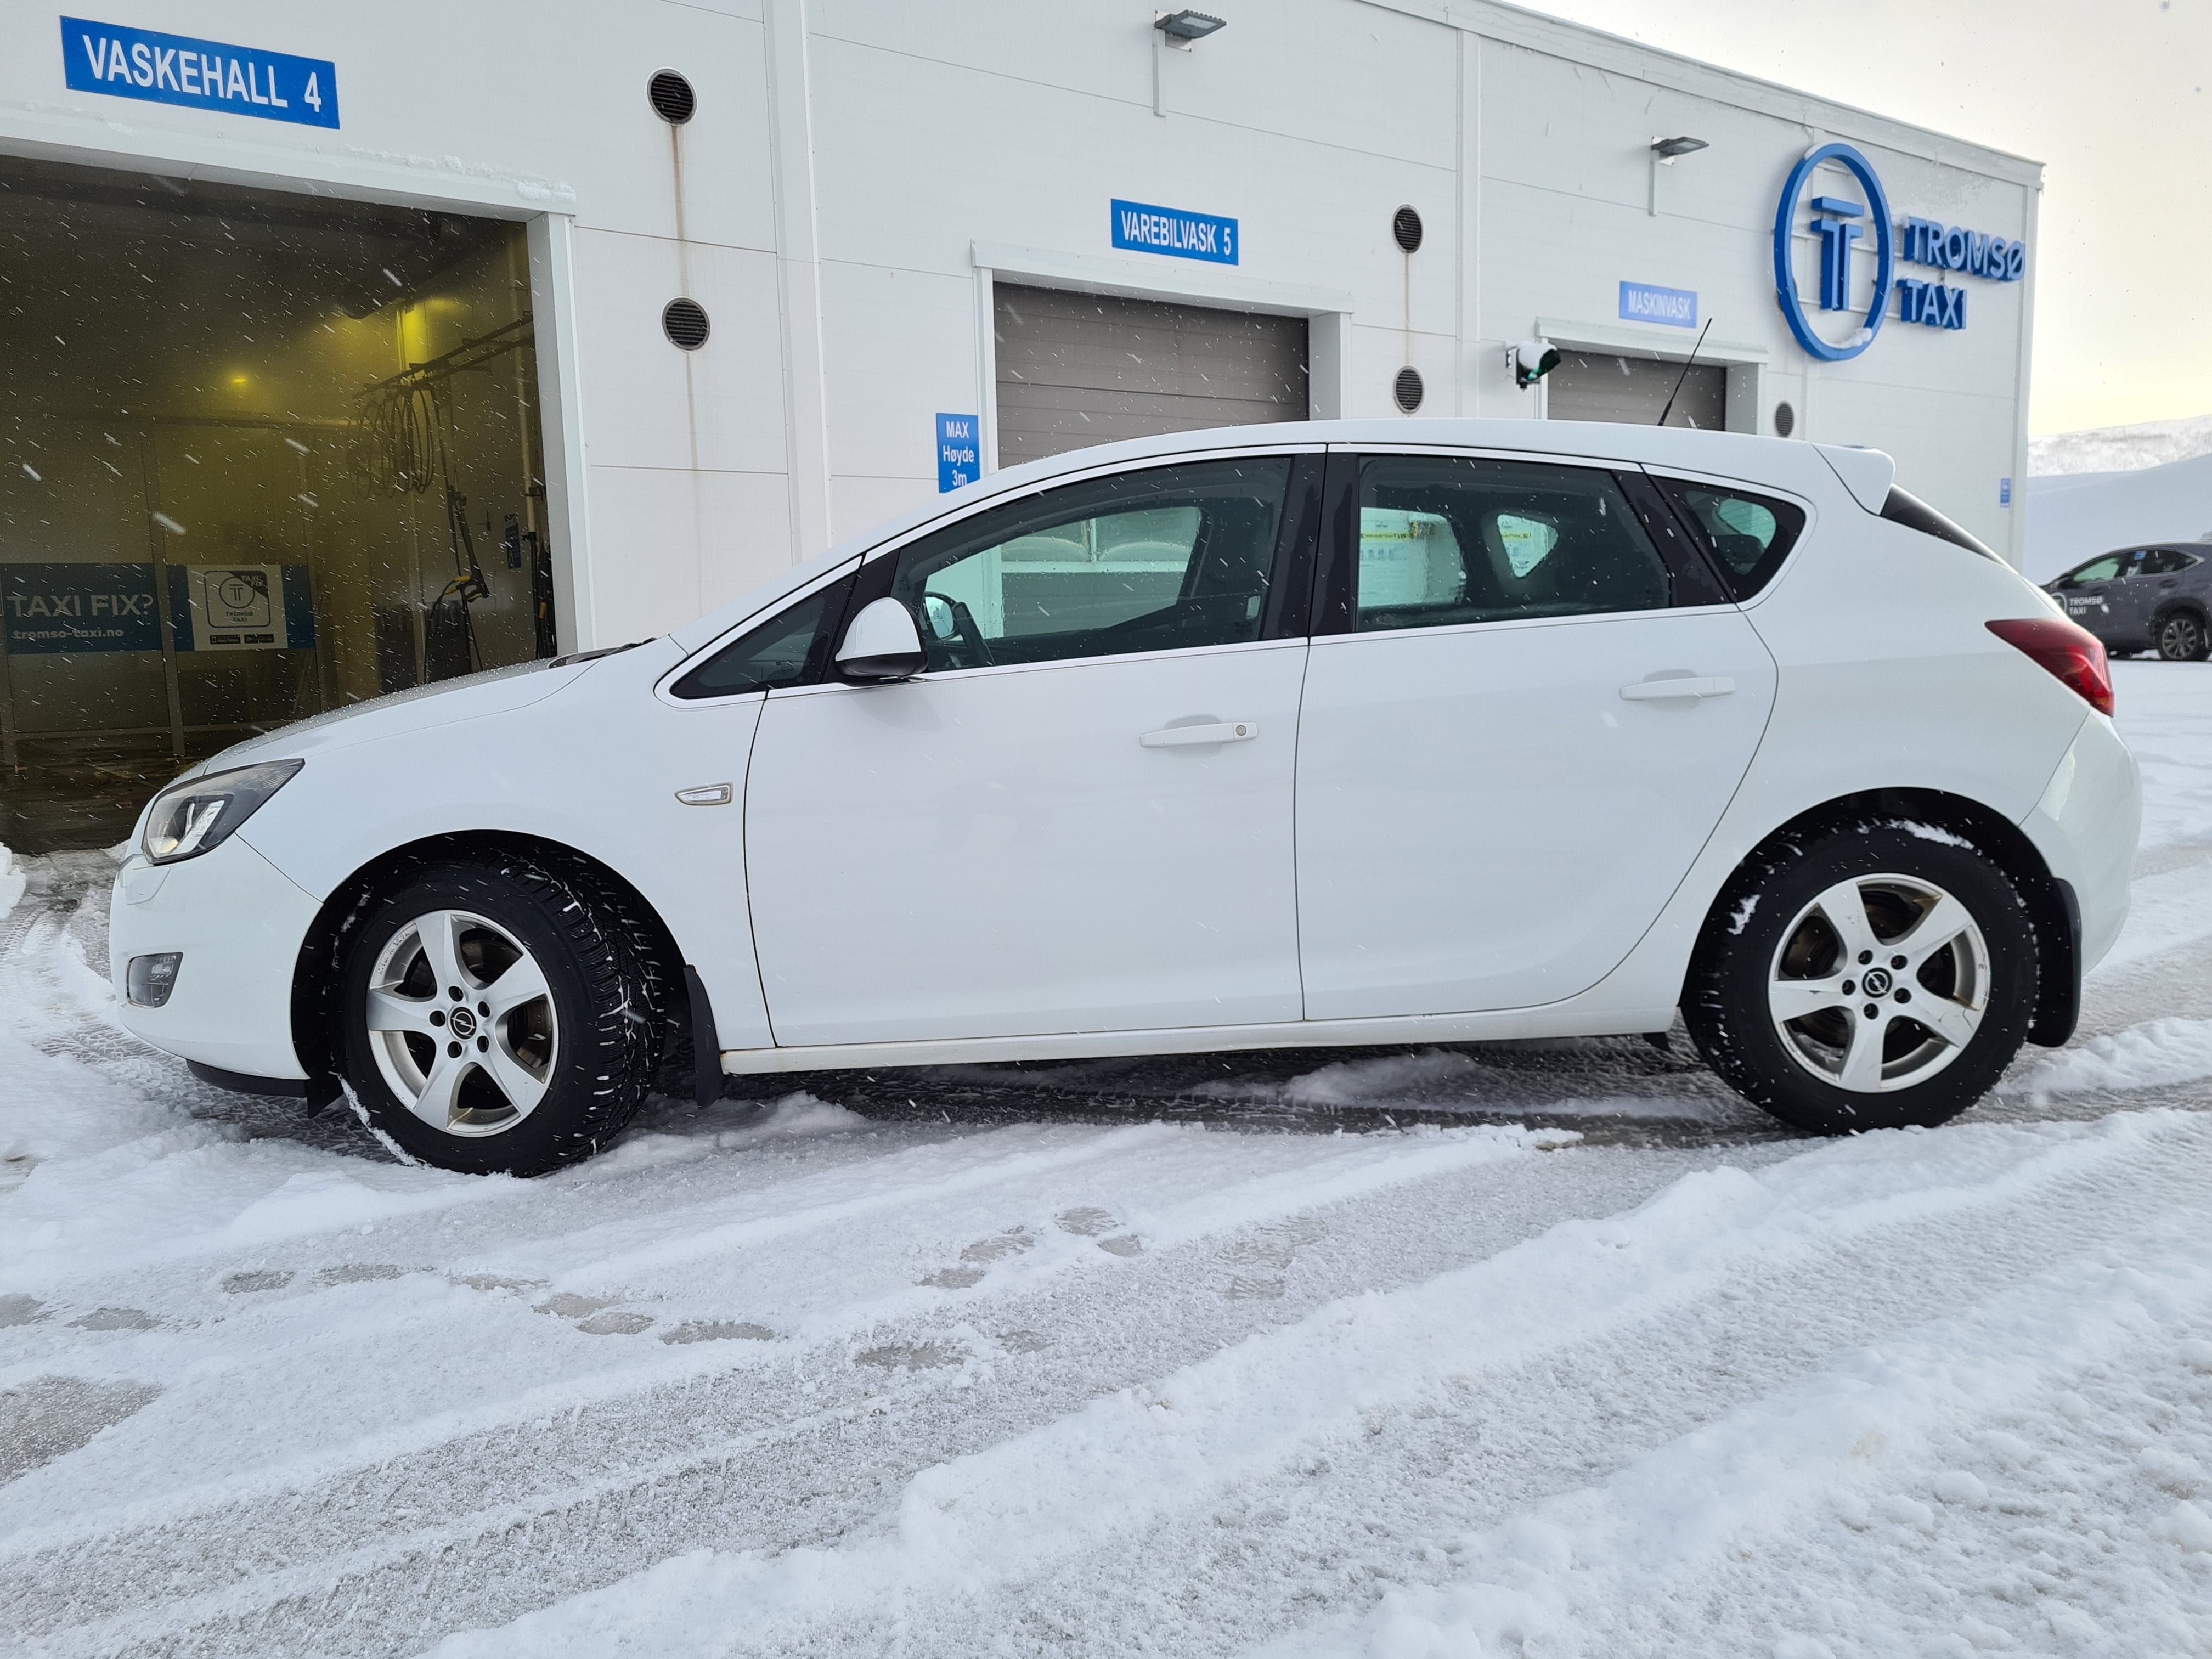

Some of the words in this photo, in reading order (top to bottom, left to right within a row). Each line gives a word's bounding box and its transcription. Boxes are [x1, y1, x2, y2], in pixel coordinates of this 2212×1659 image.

[82, 35, 288, 108] VASKEHALL
[304, 71, 321, 113] 4
[1121, 210, 1217, 253] VAREBILVASK
[1223, 227, 1231, 256] 5
[1904, 216, 2025, 281] TROMSØ
[1628, 290, 1690, 320] MASKINVASK
[1897, 279, 1966, 330] TAXI
[946, 421, 969, 438] MAX
[943, 445, 974, 466] Høyde
[952, 469, 967, 487] 3m
[6, 595, 81, 618] TAXI
[91, 594, 154, 616] FIX?
[2069, 606, 2086, 615] TAXI
[13, 627, 124, 641] tromso-taxi.no
